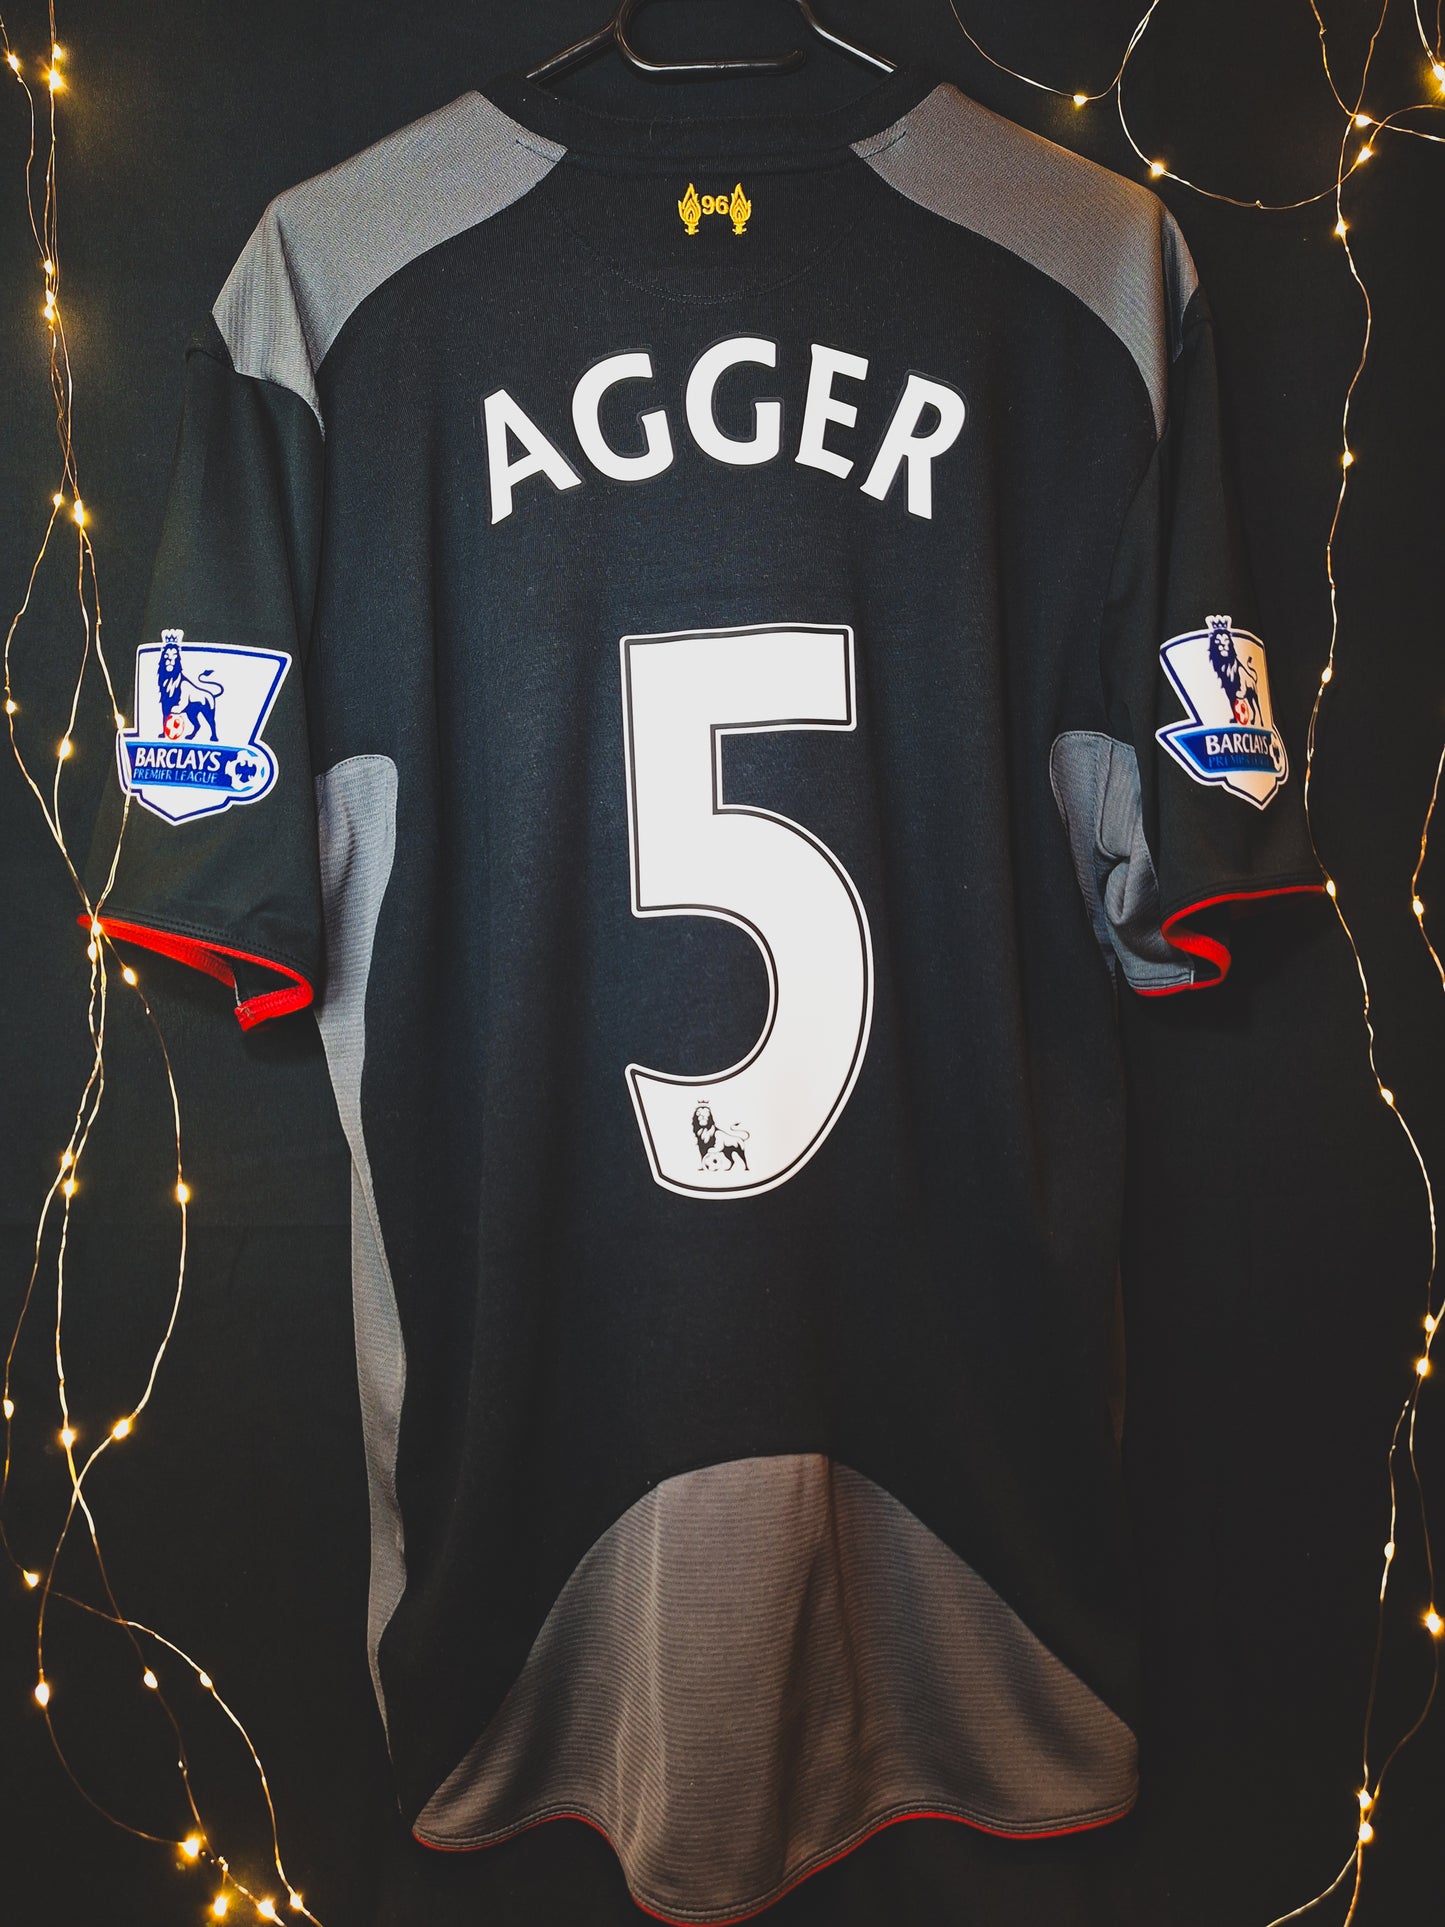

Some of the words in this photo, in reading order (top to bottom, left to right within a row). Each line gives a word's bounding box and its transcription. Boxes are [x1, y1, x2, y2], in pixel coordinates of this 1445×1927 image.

[701, 195, 730, 215] 96
[484, 338, 966, 524] AGGER
[1205, 733, 1269, 756] BARCLAYS
[135, 747, 222, 772] BARCLAYS
[133, 768, 172, 780] PREMIER
[175, 770, 219, 784] LEAGUE
[620, 623, 874, 1200] 5
